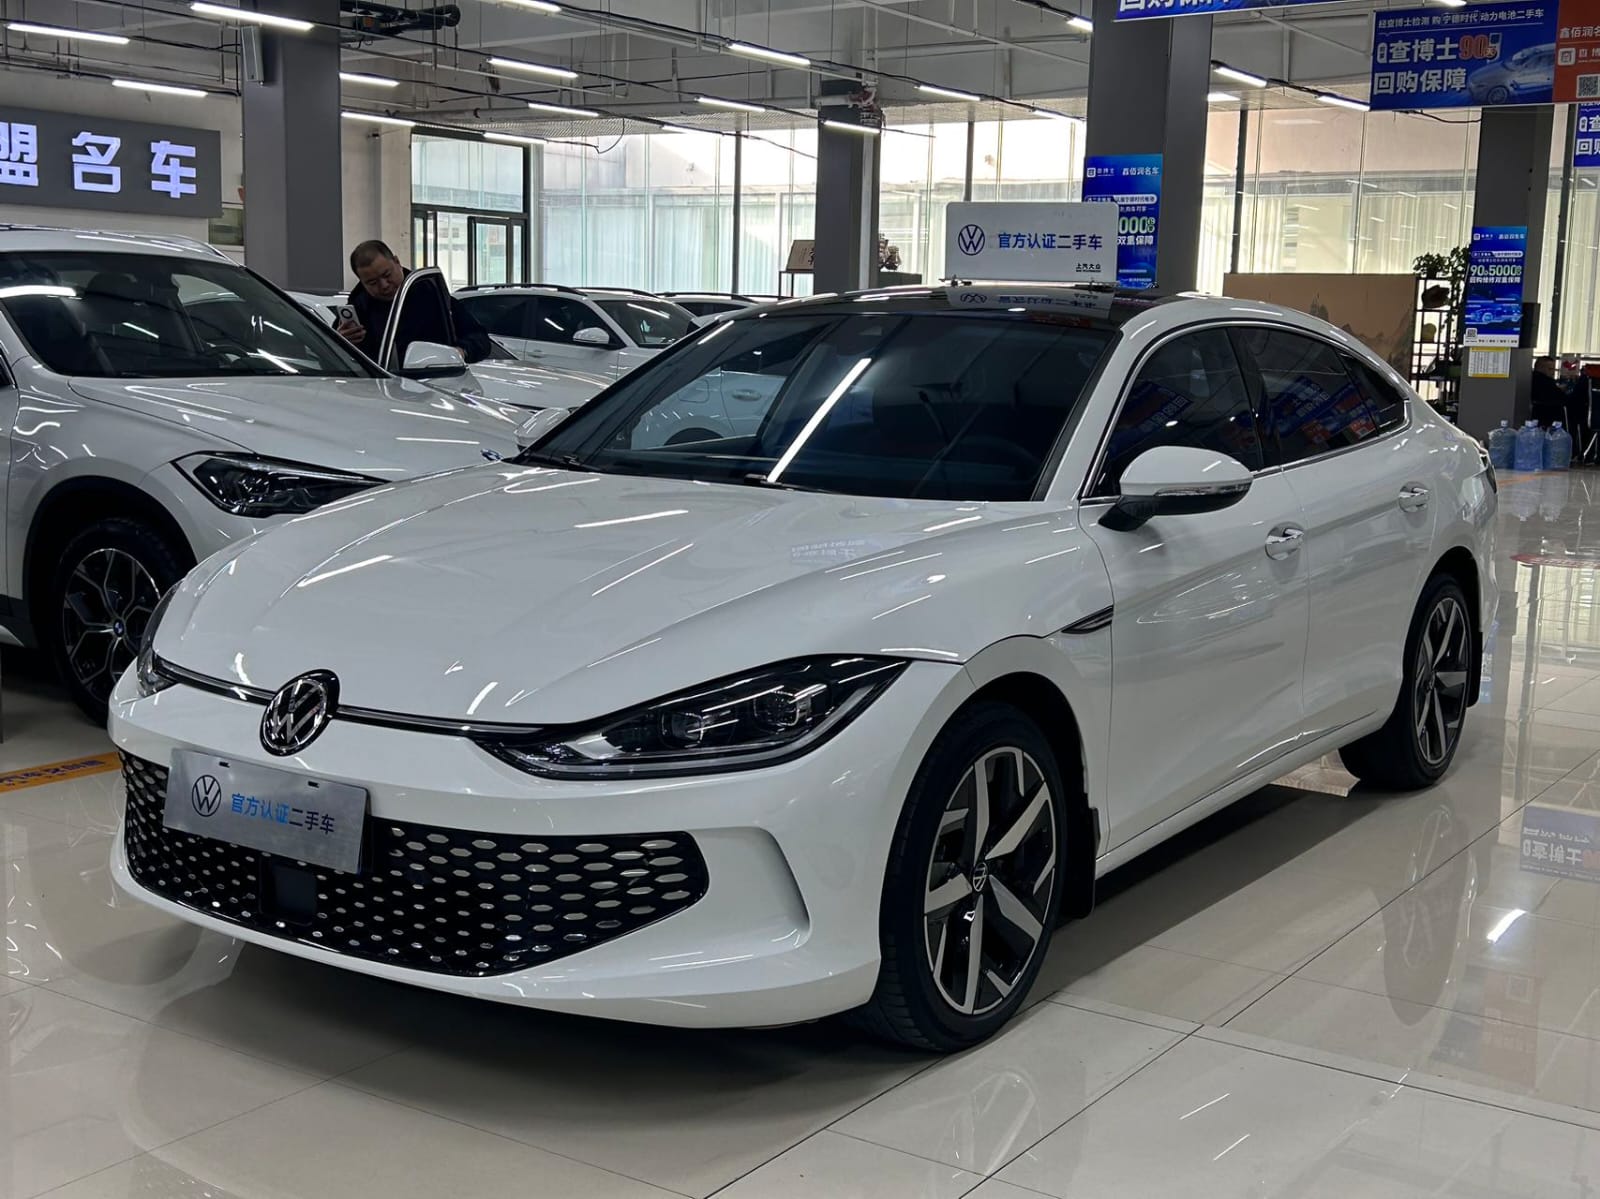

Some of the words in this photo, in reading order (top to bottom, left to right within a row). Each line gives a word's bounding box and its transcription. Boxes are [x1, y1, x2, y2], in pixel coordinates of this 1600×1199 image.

[1373, 68, 1467, 95] 回购保障
[0, 121, 197, 198] 盟名车
[998, 233, 1103, 250] 官方认证二手车
[231, 793, 335, 835] 官方认证二手车
